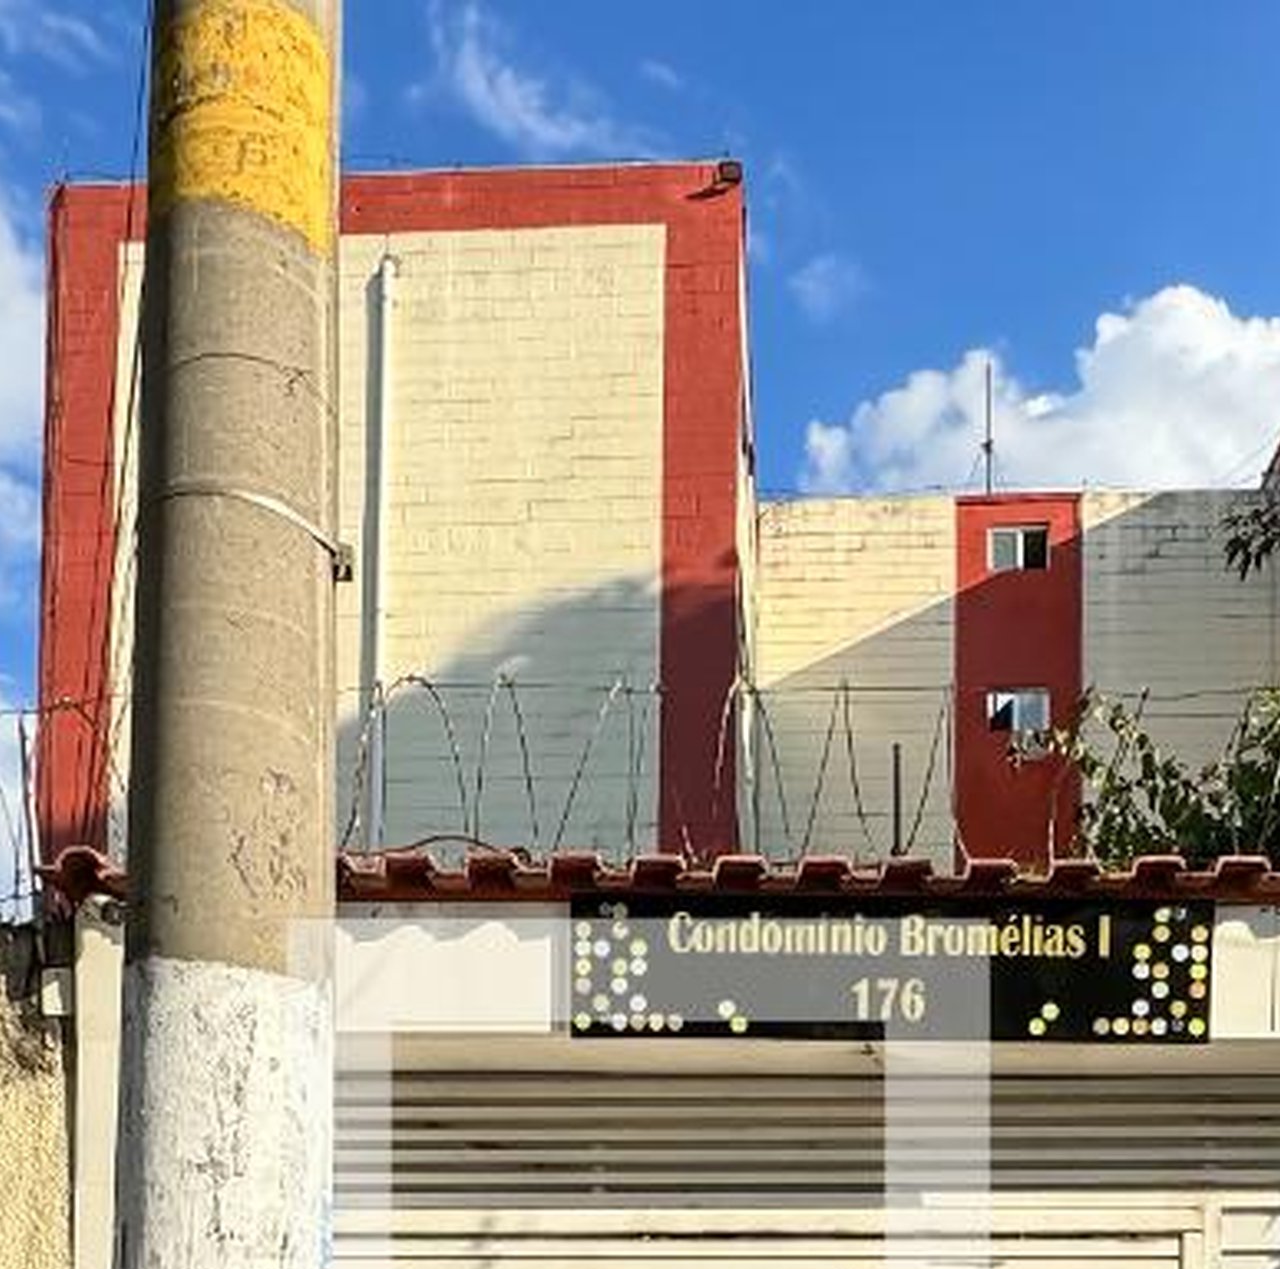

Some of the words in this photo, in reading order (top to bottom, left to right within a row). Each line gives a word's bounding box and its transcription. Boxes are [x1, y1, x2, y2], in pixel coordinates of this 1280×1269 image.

[900, 914, 1087, 957] Bromélias
[1098, 915, 1111, 958] I
[850, 976, 927, 1021] 176
